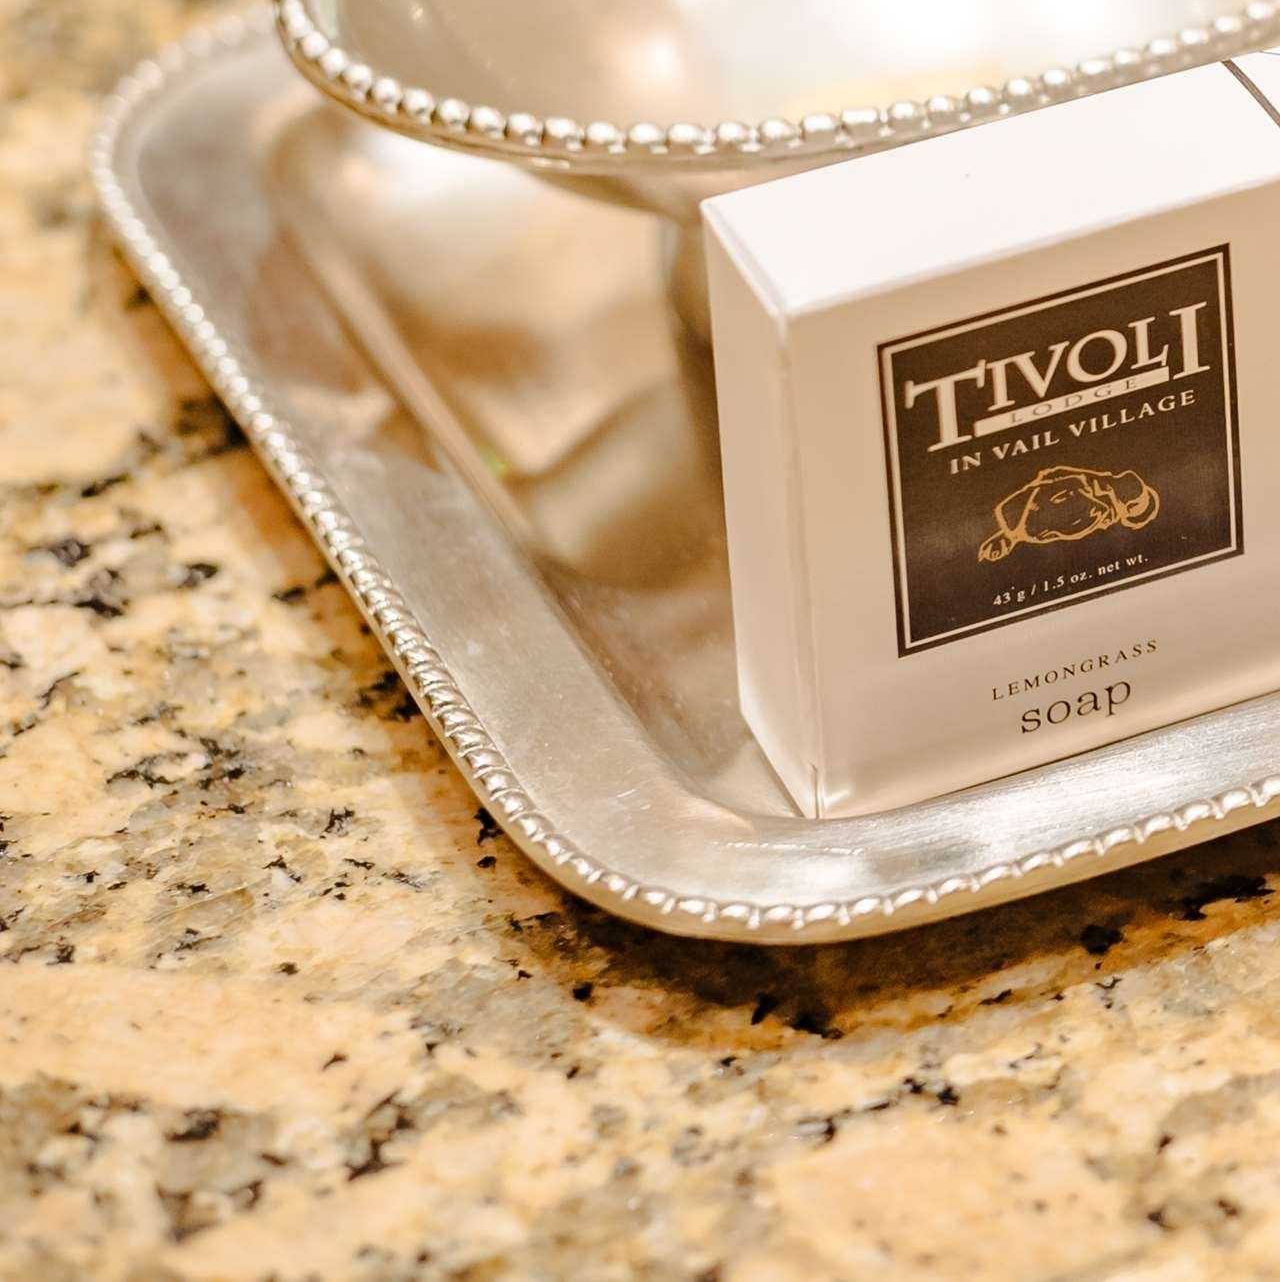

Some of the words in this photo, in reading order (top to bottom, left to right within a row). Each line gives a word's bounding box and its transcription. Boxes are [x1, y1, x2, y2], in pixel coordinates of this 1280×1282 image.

[904, 301, 1211, 453] TIVOLI
[1010, 379, 1138, 424] LODGE
[950, 452, 982, 475] IN
[992, 430, 1060, 460] VAIL
[1068, 389, 1196, 438] VILLAGE
[992, 591, 1012, 606] 43
[1016, 589, 1026, 603] g
[1030, 583, 1037, 596] /
[1043, 575, 1065, 592] 1.5
[1070, 570, 1093, 584] oz.
[1097, 560, 1121, 576] net
[1125, 553, 1149, 567] wt.
[992, 638, 1158, 702] LEMONGRASS
[1020, 680, 1132, 734] soap
